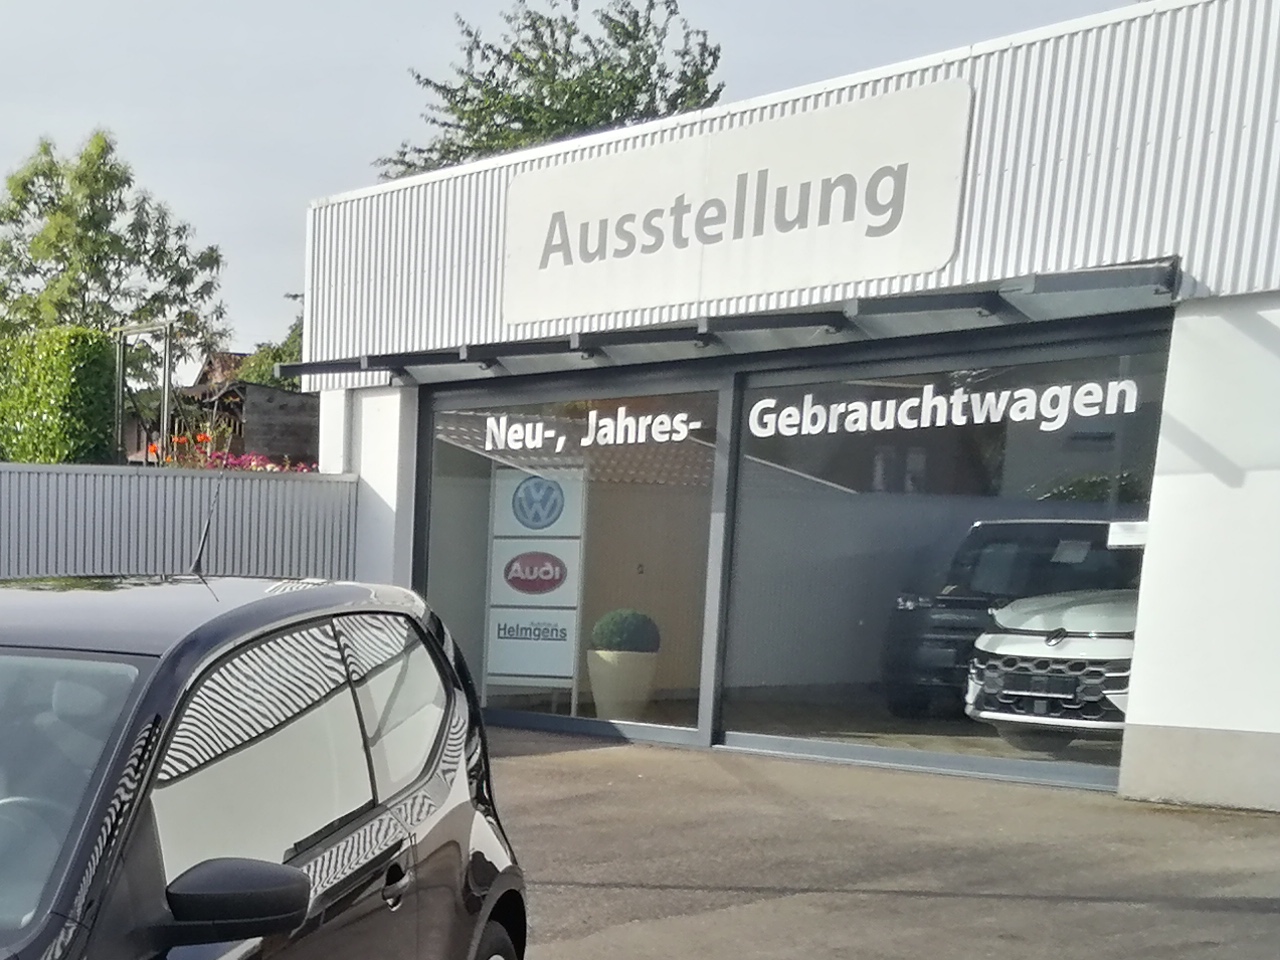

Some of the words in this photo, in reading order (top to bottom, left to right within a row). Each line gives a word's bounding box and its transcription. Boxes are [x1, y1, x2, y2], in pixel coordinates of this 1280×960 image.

[539, 162, 910, 271] Ausstellung
[485, 413, 566, 454] Neu-,
[580, 407, 702, 446] Jahres-
[748, 376, 1138, 438] Gebrauchtwagen
[507, 561, 561, 581] Audi
[497, 622, 567, 641] Helmgens
